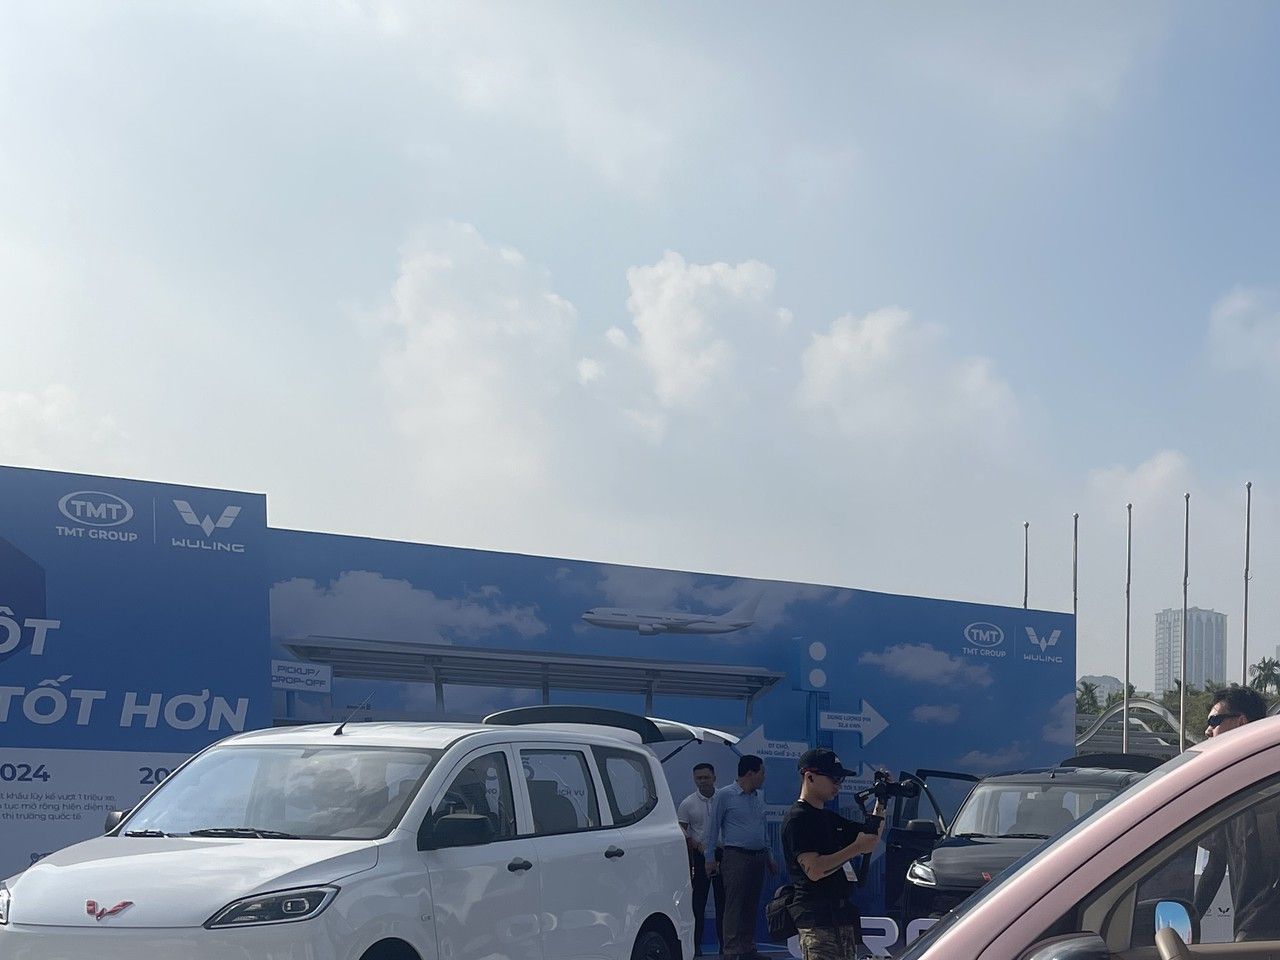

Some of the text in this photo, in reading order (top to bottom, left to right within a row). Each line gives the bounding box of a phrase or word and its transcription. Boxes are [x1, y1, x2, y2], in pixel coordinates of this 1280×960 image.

[71, 500, 122, 520] TMT
[56, 526, 138, 542] TMT GROUP
[172, 537, 245, 553] WULING
[970, 628, 999, 642] TMT
[962, 647, 1006, 658] TMT GROUP
[1023, 653, 1063, 663] WULING
[0, 675, 249, 731] TỐT HƠN
[139, 767, 177, 785] 20
